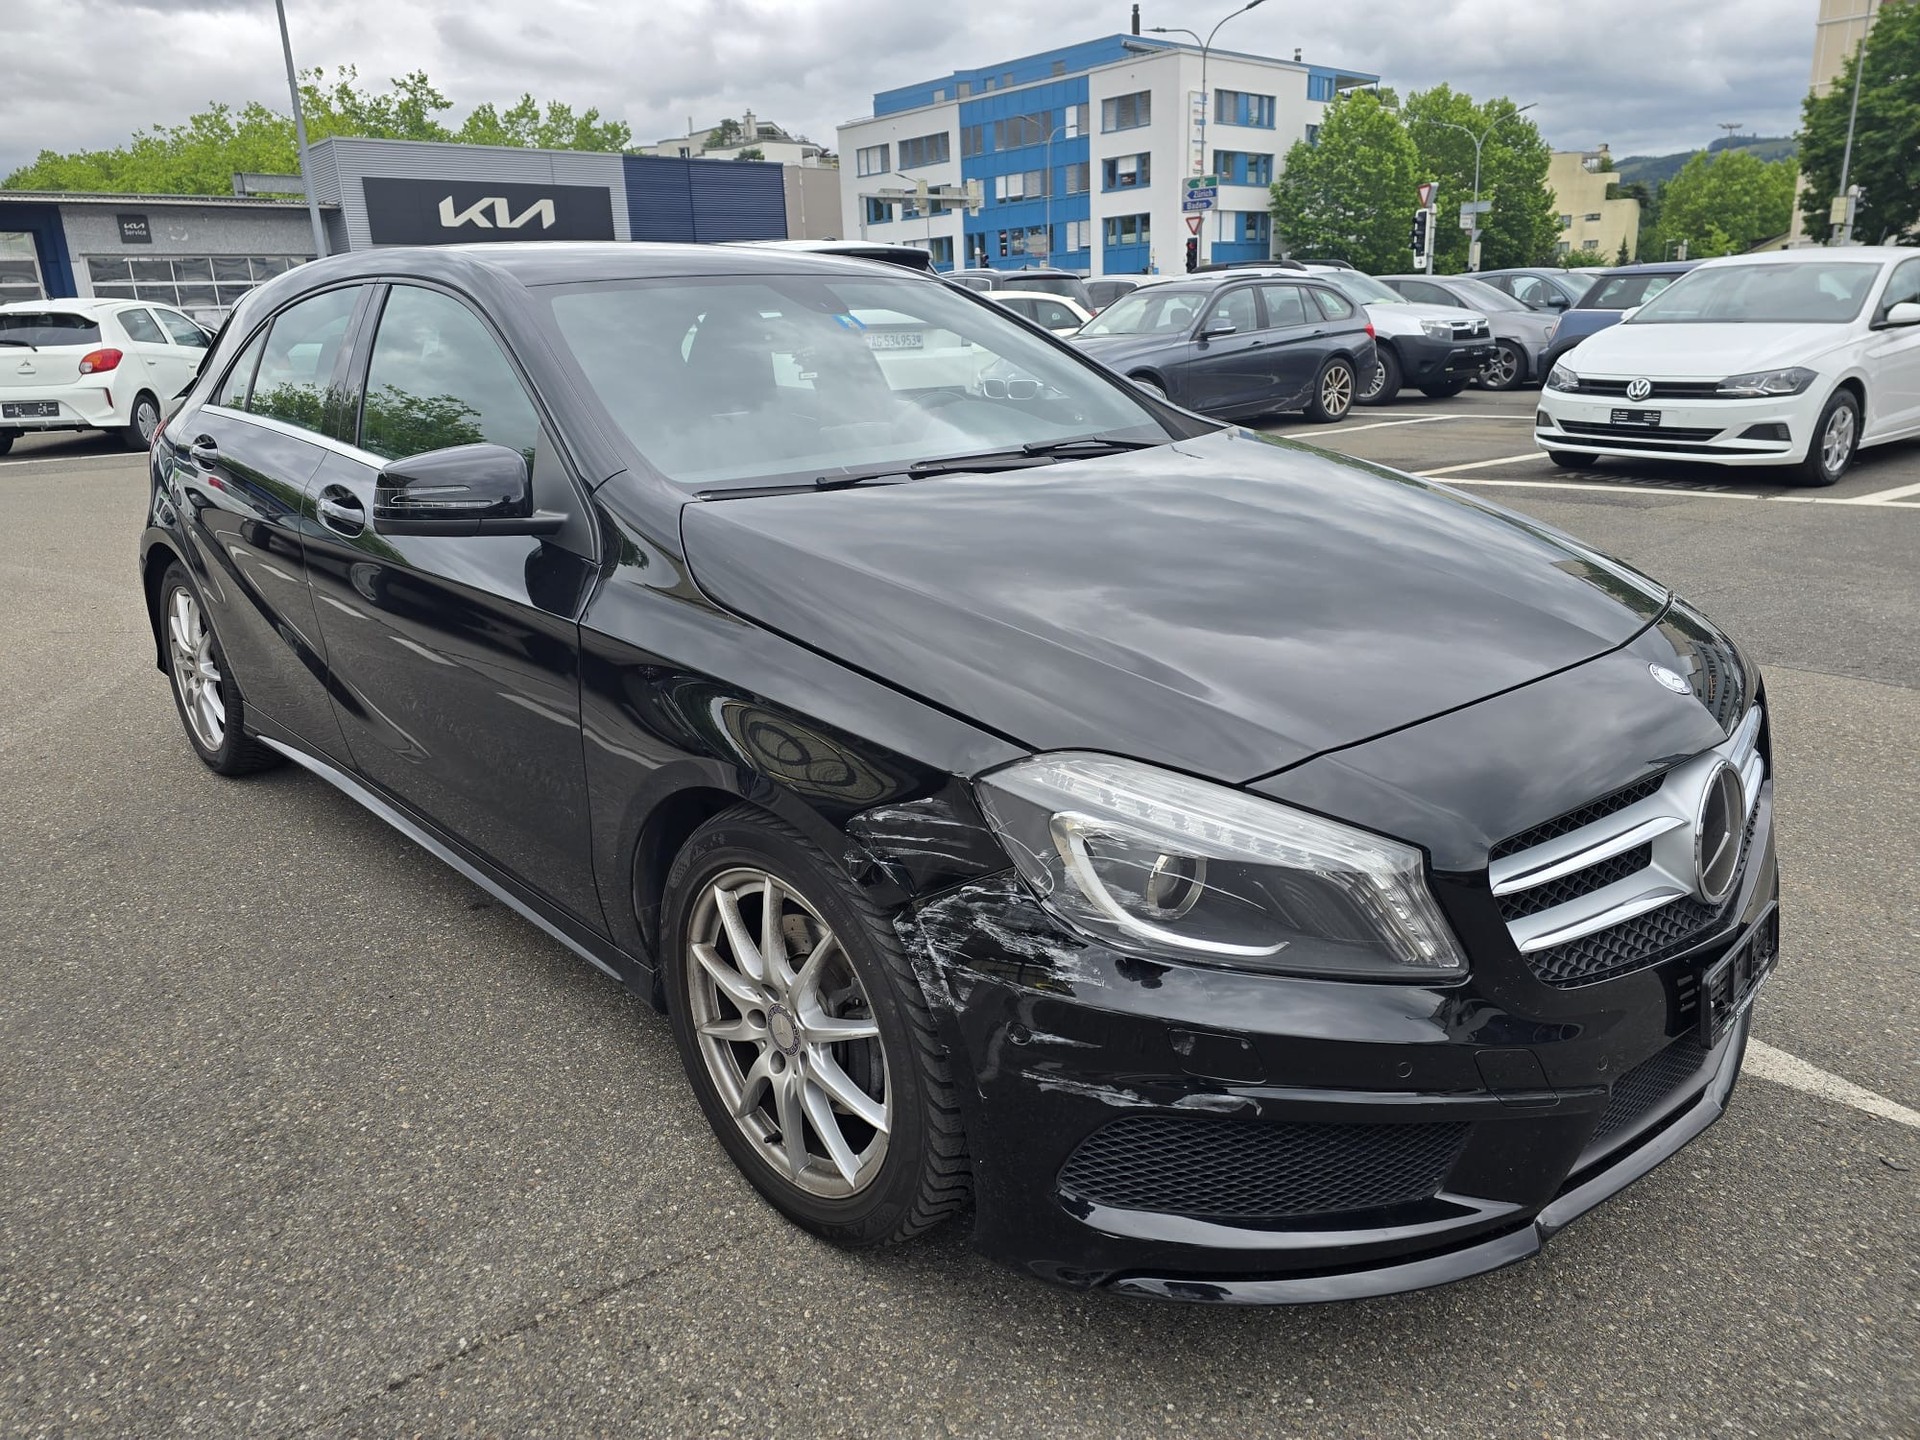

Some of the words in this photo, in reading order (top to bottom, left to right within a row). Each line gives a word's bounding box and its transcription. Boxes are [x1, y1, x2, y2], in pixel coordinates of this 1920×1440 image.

[1193, 189, 1214, 198] Zürich
[1186, 201, 1207, 210] Baden
[871, 335, 882, 347] AG
[1552, 471, 1733, 492] KUNDEN
